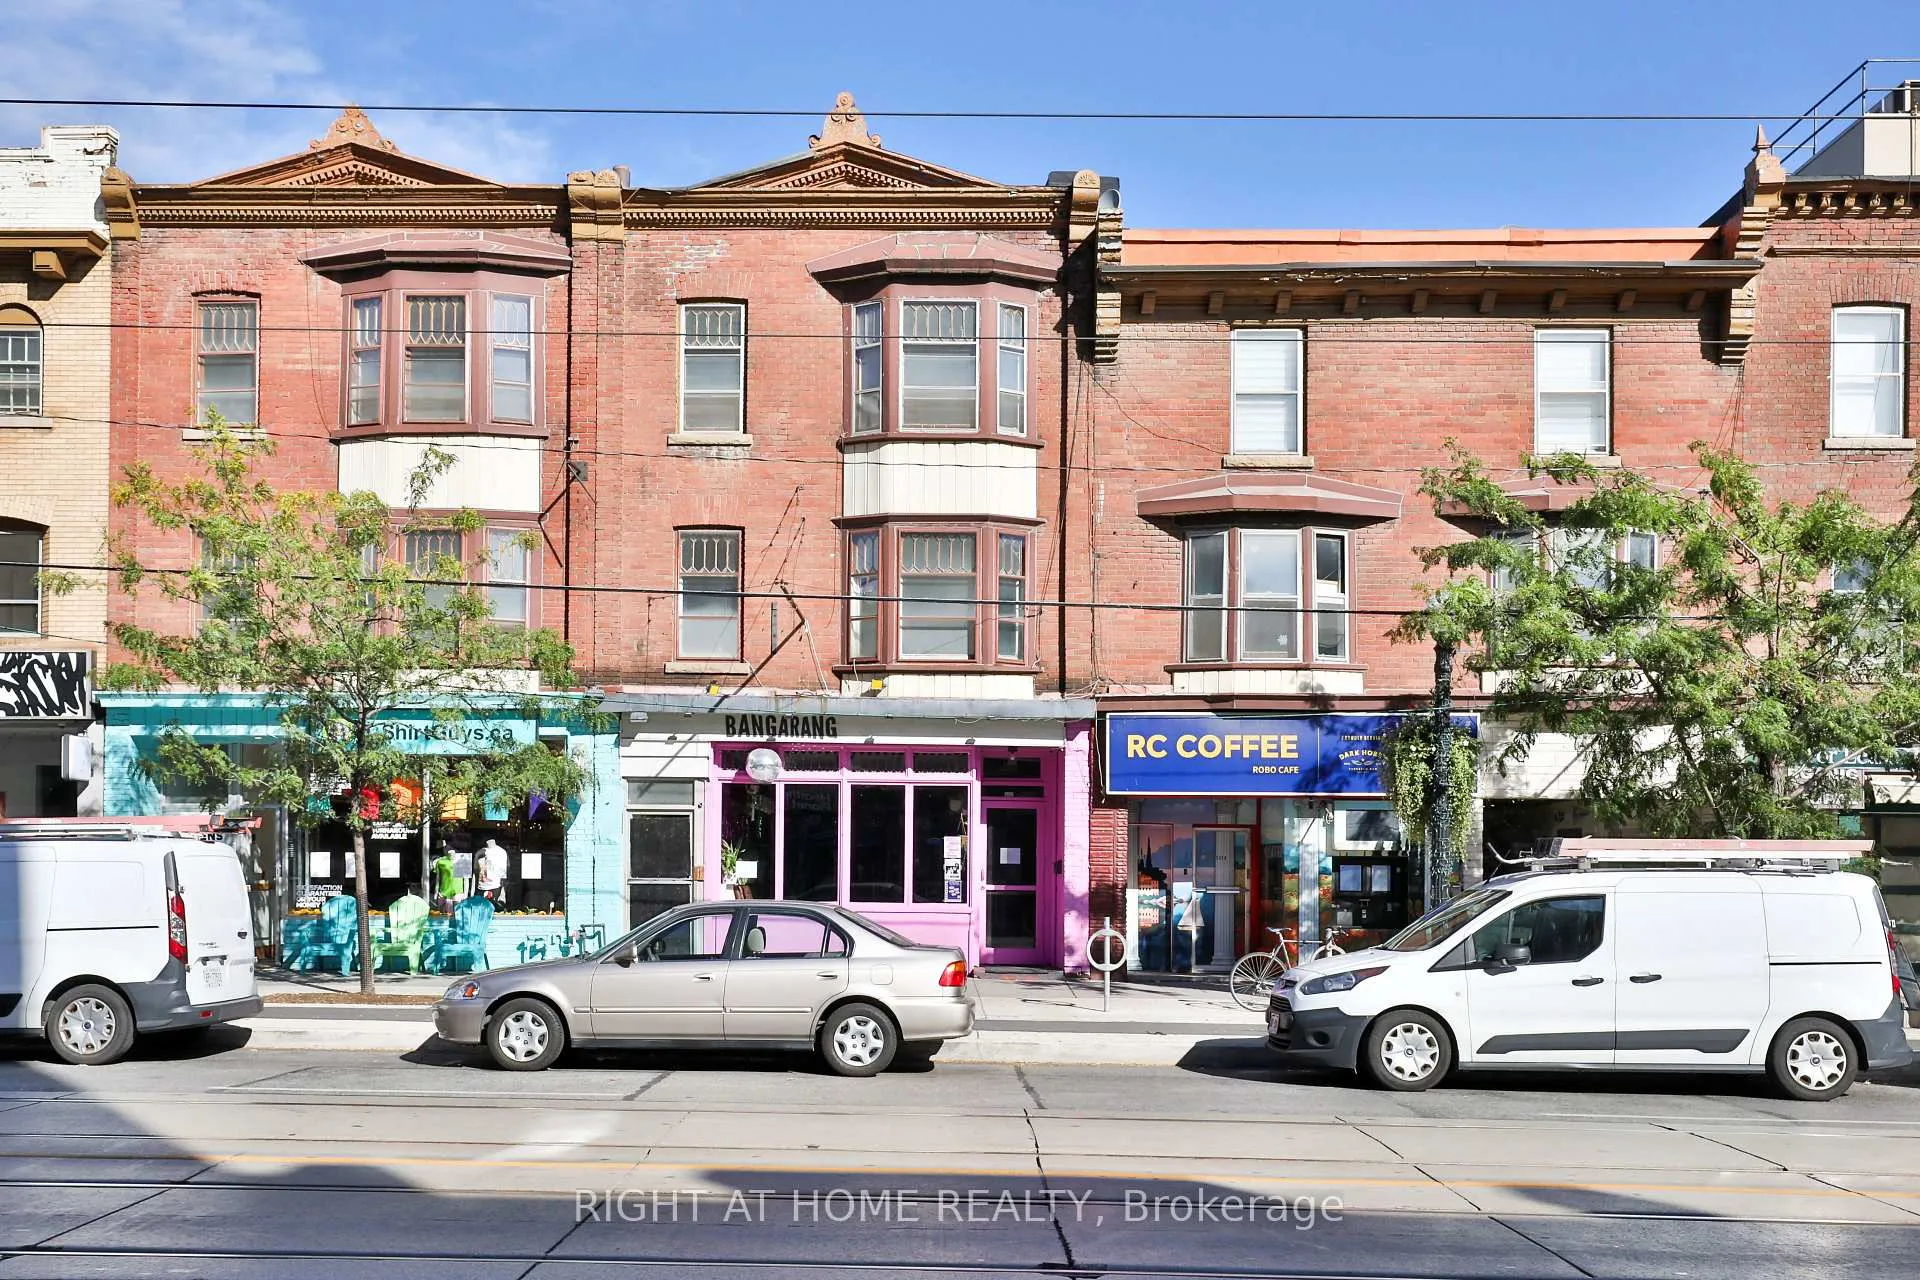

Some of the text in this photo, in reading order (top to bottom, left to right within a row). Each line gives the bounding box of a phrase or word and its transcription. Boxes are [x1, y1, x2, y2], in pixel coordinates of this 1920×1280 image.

[725, 713, 838, 738] BANGARANG
[1127, 734, 1299, 759] RC COFFEE
[1338, 749, 1360, 761] DARK
[1252, 765, 1300, 774] ROBO CAFE
